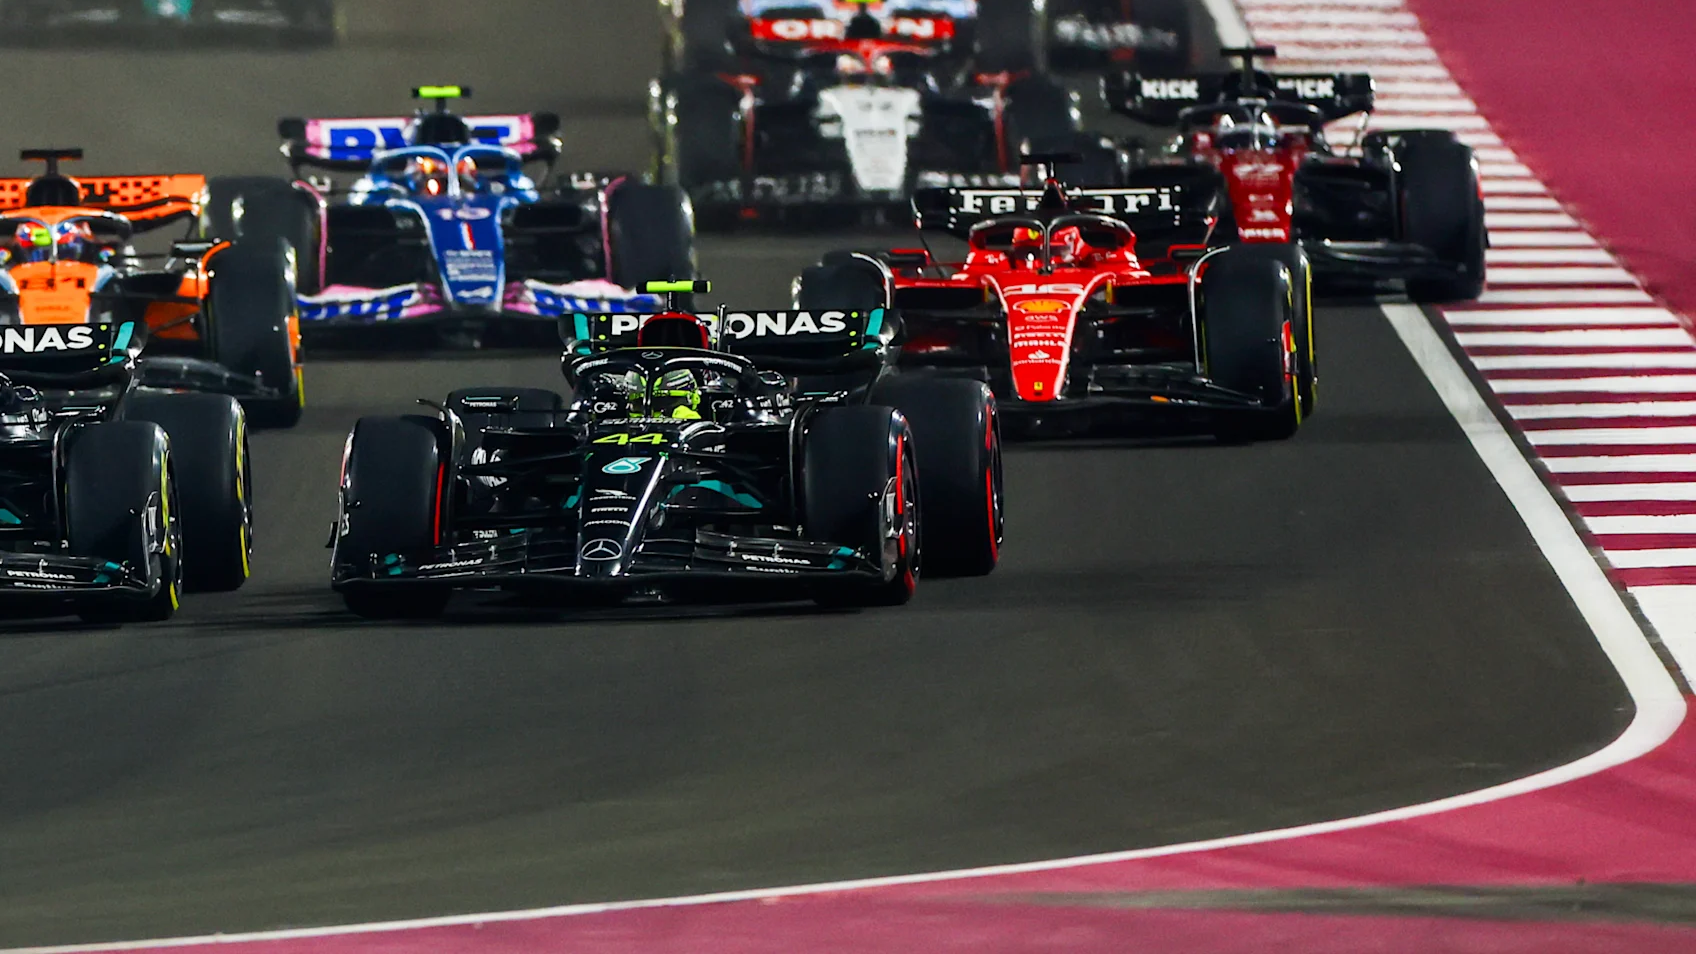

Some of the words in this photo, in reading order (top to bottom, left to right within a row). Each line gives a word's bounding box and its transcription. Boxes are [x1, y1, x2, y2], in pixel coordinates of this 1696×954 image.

[1141, 79, 1199, 98] KICK
[592, 433, 668, 445] 44
[419, 558, 483, 571] PETRONAS
[741, 553, 811, 565] PETRONAS
[6, 569, 76, 580] PETRONAS
